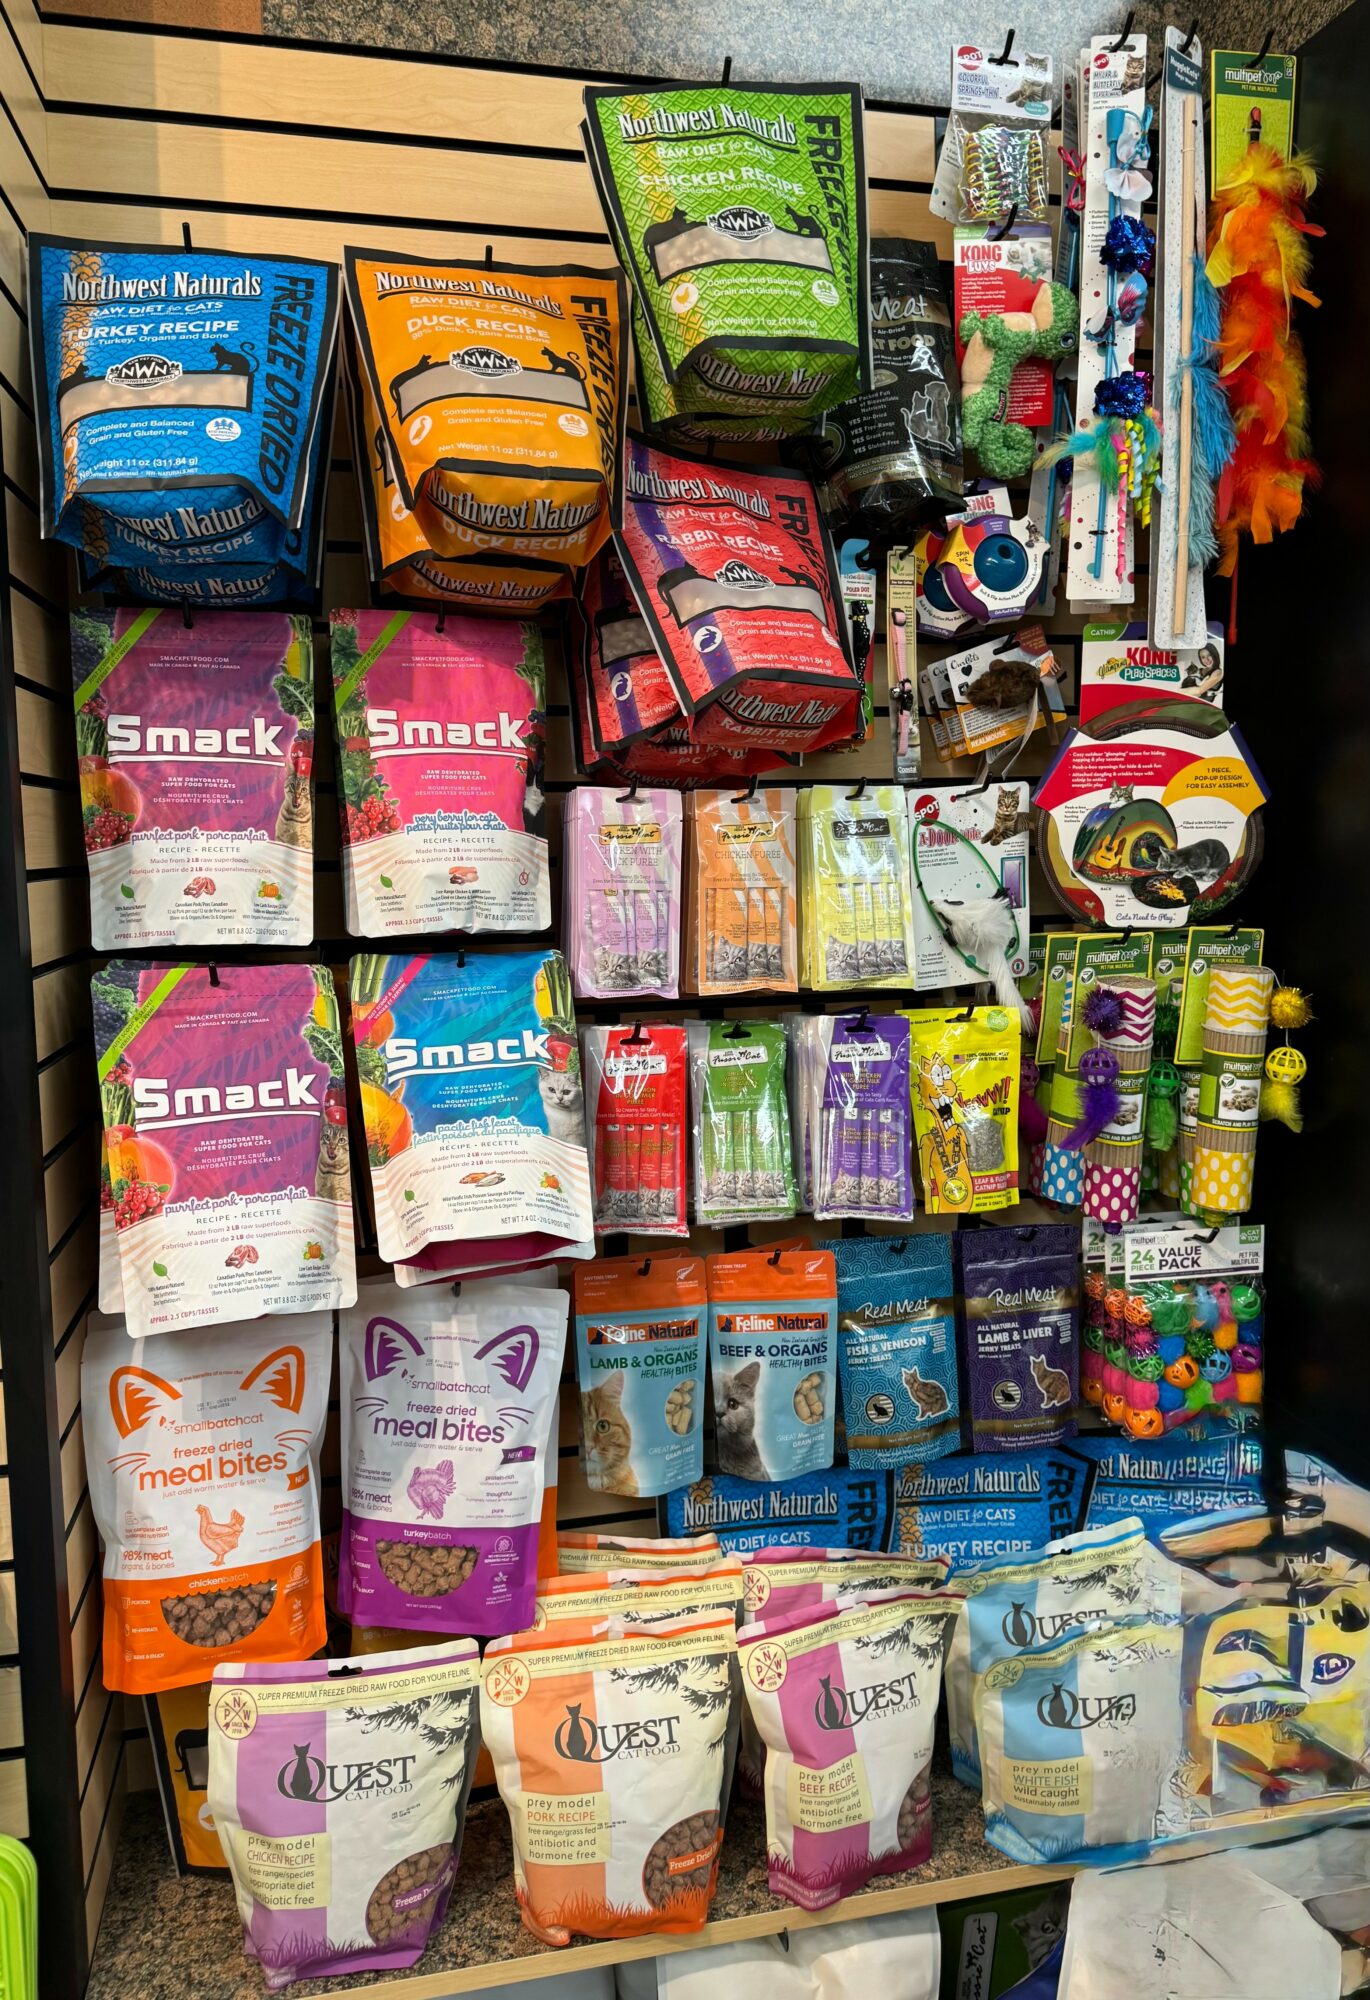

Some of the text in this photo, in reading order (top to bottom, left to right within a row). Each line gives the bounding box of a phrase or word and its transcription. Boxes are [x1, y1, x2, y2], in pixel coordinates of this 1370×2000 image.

[1225, 71, 1262, 82] multipet
[616, 104, 796, 145] Northwest Naturals
[639, 167, 806, 195] CHICKEN RECIPE
[960, 245, 1002, 263] KONG
[967, 260, 996, 273] LUVS
[61, 270, 262, 302] Northwest Naturals
[374, 272, 562, 315] Northwest Naturals
[89, 302, 224, 318] RAW DIET CATS
[65, 321, 239, 341] TURKEY RECIPE
[265, 274, 315, 378] FREEZE
[407, 316, 551, 338] DUCK RECIPE
[139, 335, 177, 343] Organs
[202, 332, 229, 340] Bone
[121, 363, 169, 378] NWN
[86, 420, 195, 437] Complete and Balanced
[89, 434, 112, 445] Grain
[134, 430, 163, 438] Gluten
[166, 428, 188, 436] Free
[627, 460, 771, 518] Northwest Naturals
[657, 531, 783, 557] RABBIT RECIPE
[1090, 628, 1116, 637] CATNIP
[1126, 648, 1177, 665] KONG
[107, 714, 285, 755] Smack
[367, 708, 528, 749] Smack
[914, 801, 939, 821] SPOT
[1198, 945, 1231, 957] multipet
[186, 1010, 258, 1022] SMACKPETFOOD.COM
[386, 1030, 552, 1068] Smack
[133, 1068, 320, 1117] Smack
[194, 1144, 215, 1152] SUPER
[217, 1134, 264, 1144] DEHYDRATED
[196, 1208, 282, 1224] RECIPE RECETTE
[1131, 1246, 1201, 1264] 24 VALUE
[1131, 1256, 1201, 1271] PIECE PACK
[993, 1287, 1056, 1306] Real Meat
[863, 1297, 929, 1319] Real Meat
[736, 1315, 826, 1332] Feline Natural
[607, 1324, 696, 1342] Feline Natural
[978, 1331, 1010, 1344] LAMB
[1013, 1331, 1021, 1340] &
[1023, 1326, 1052, 1340] LIVER
[720, 1343, 828, 1357] BEEF & ORGANS
[847, 1343, 869, 1356] FISH
[871, 1344, 878, 1353] &
[882, 1336, 926, 1352] VENISON
[590, 1349, 698, 1369] LAMB & ORGANS
[769, 1356, 828, 1369] HEALTHY BITES
[641, 1363, 697, 1380] HEALTHY BITES
[412, 1380, 491, 1394] smallbatchcat
[406, 1401, 477, 1416] freeze dried
[174, 1413, 264, 1434] smallbatchcat
[373, 1418, 504, 1443] meal bites
[173, 1438, 252, 1459] freeze dried
[139, 1452, 288, 1491] meal bites
[896, 1464, 1040, 1501] Northwest Naturals
[683, 1487, 838, 1528] Northwest Naturals
[916, 1507, 1016, 1524] RAW DIET CATS
[404, 1530, 452, 1542] turkeybatch
[902, 1539, 1033, 1560] TURKEY RECIPE
[189, 1571, 249, 1589] chickenbatch
[257, 1668, 470, 1701] SUPER PREMIUM FREEZE DRIED RAW FOOD FOR YOUR FELINE
[815, 1672, 918, 1732] QUEST
[866, 1698, 921, 1722] CAT FOOD
[555, 1716, 680, 1762] QUEST
[618, 1744, 680, 1761] CAT FOOD
[278, 1754, 415, 1803] QUEST
[1013, 1763, 1079, 1776] prey model
[799, 1772, 856, 1794] BEEF RECIPE
[1013, 1773, 1079, 1786] WHITE FISH
[345, 1783, 413, 1801] CAT FOOD
[1013, 1786, 1079, 1799] wild caught
[527, 1796, 595, 1811] prey model
[527, 1812, 595, 1823] PORK RECIPE
[528, 1836, 597, 1848] antibiotic and
[529, 1849, 597, 1860] hormone free
